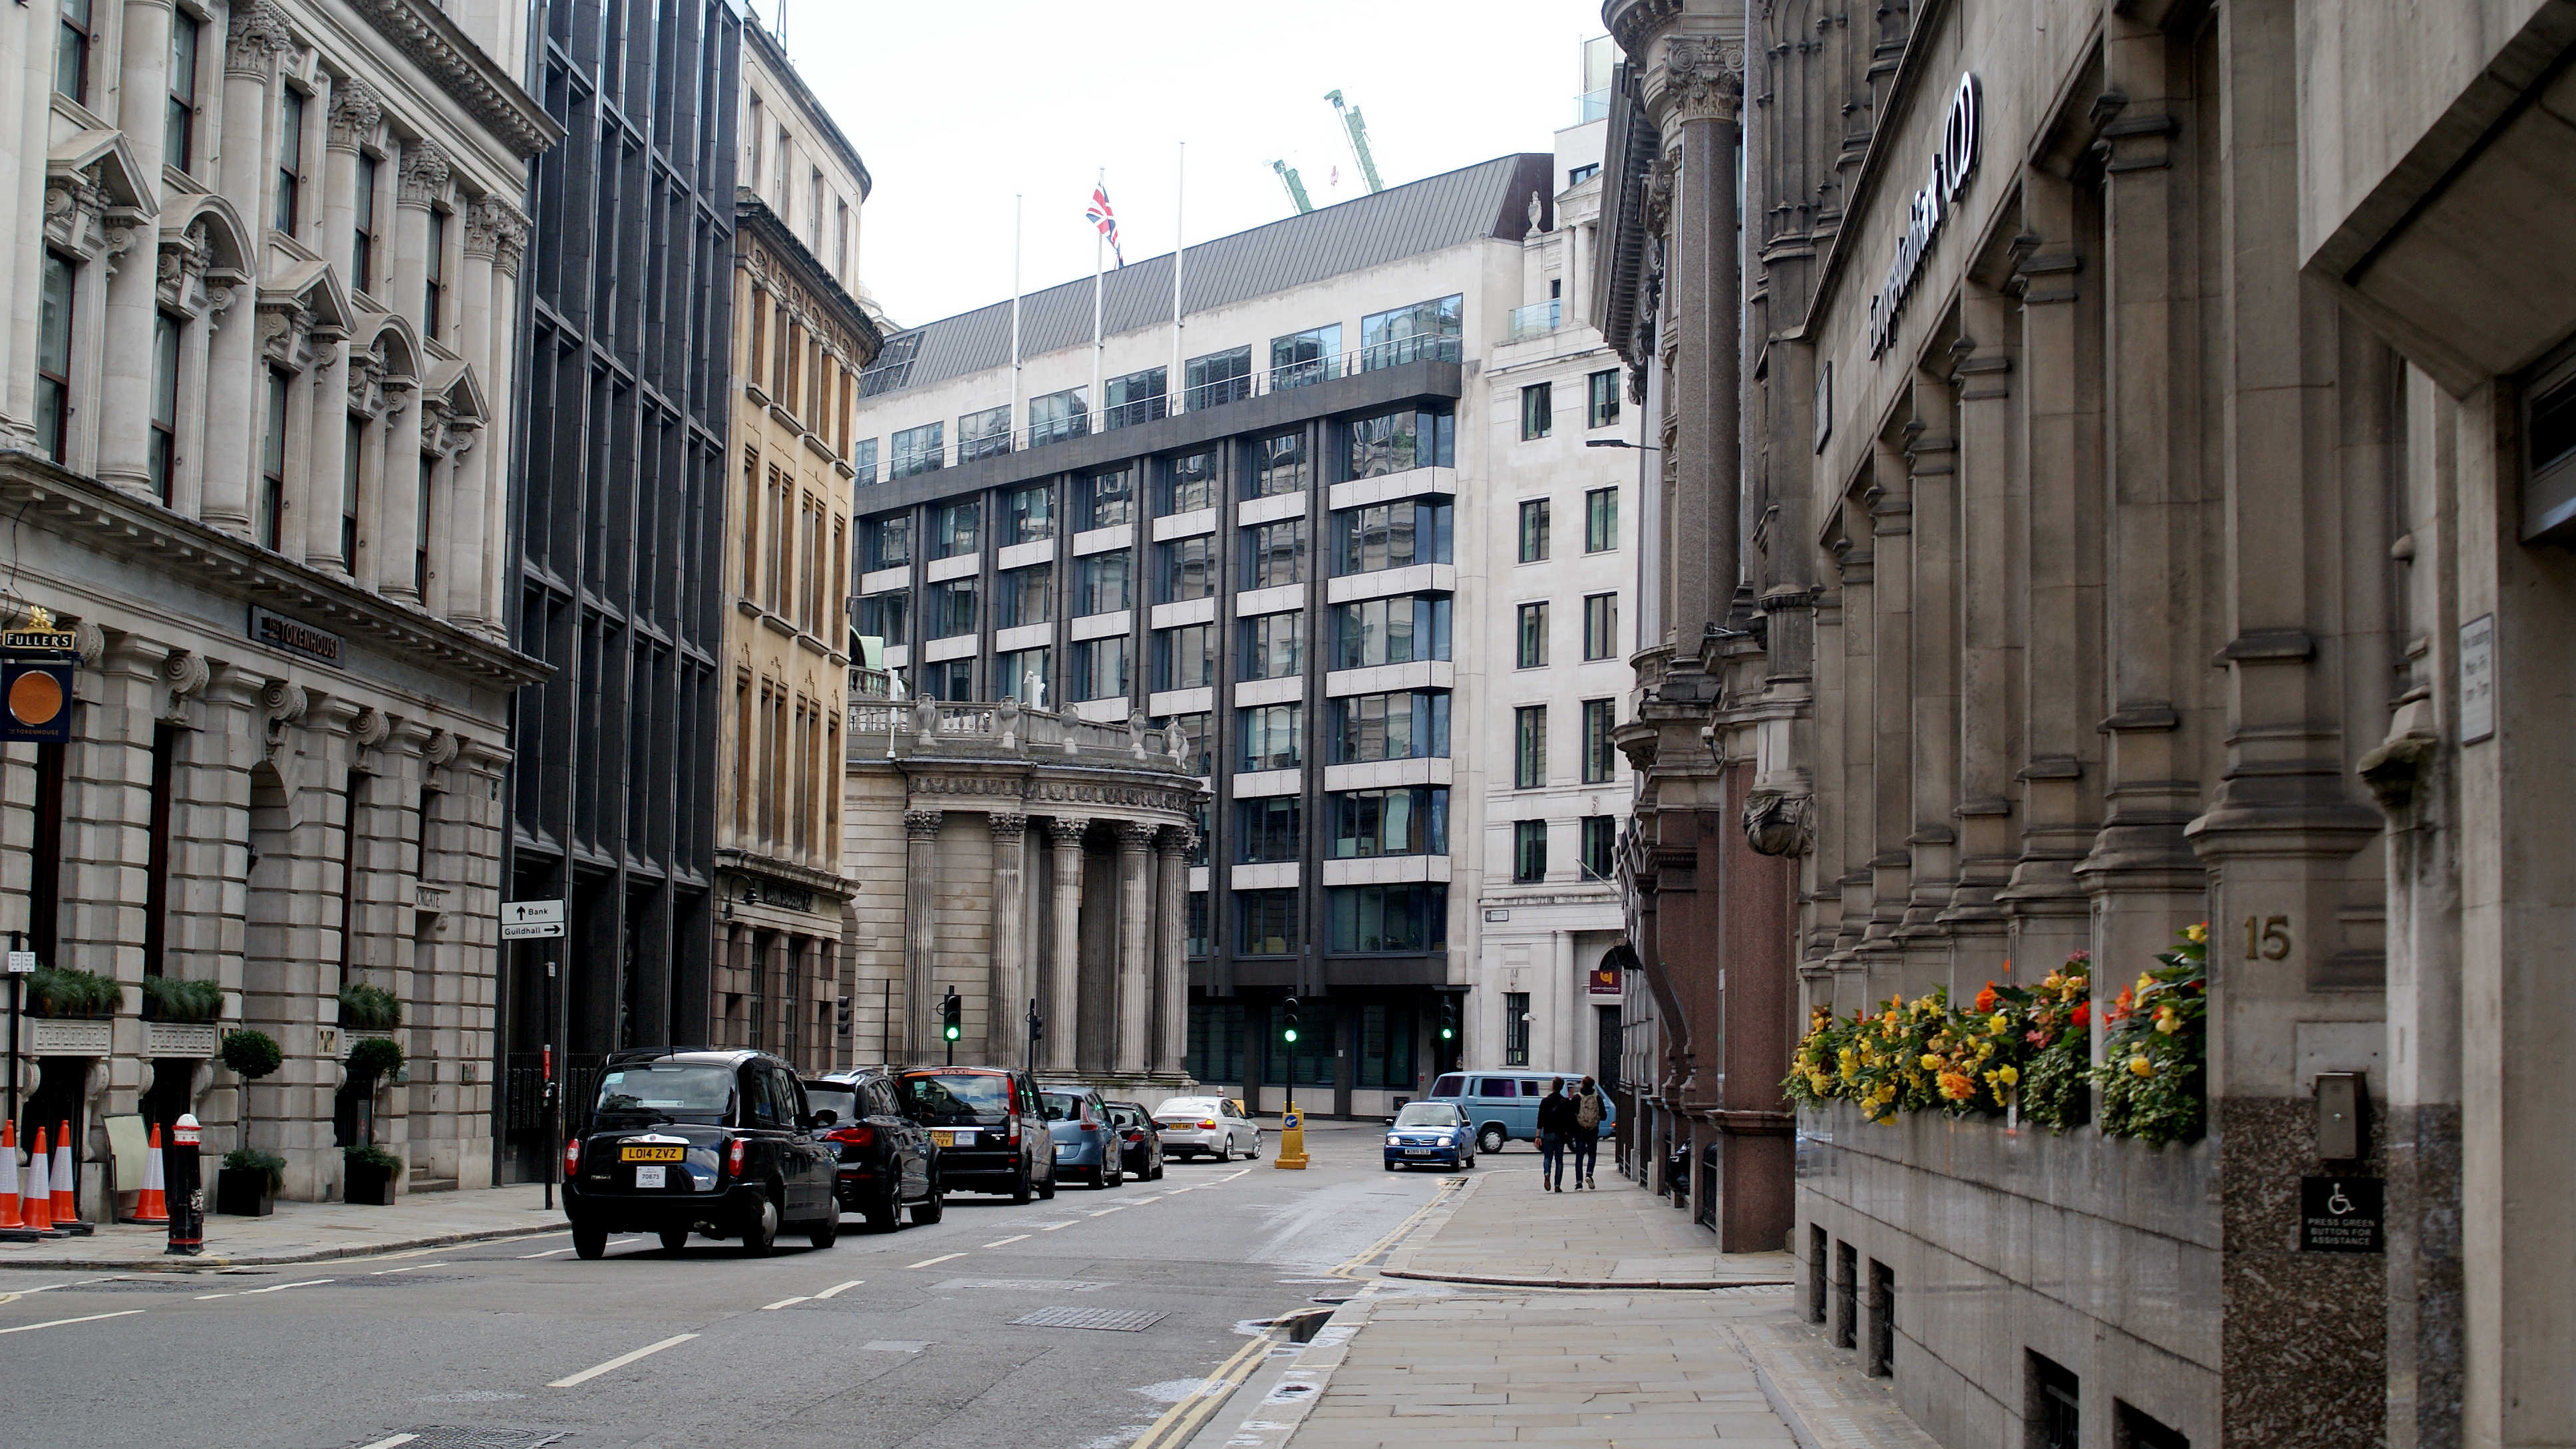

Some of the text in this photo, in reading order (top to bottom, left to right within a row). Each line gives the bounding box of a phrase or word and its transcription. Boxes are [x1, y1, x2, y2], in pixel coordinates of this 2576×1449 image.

[7, 633, 69, 647] FULLER'S
[281, 622, 339, 659] TOKENHOUSE
[2245, 915, 2291, 961] 15
[655, 1148, 677, 1158] ZVZ
[2311, 1237, 2370, 1245] ASSISTANCE
